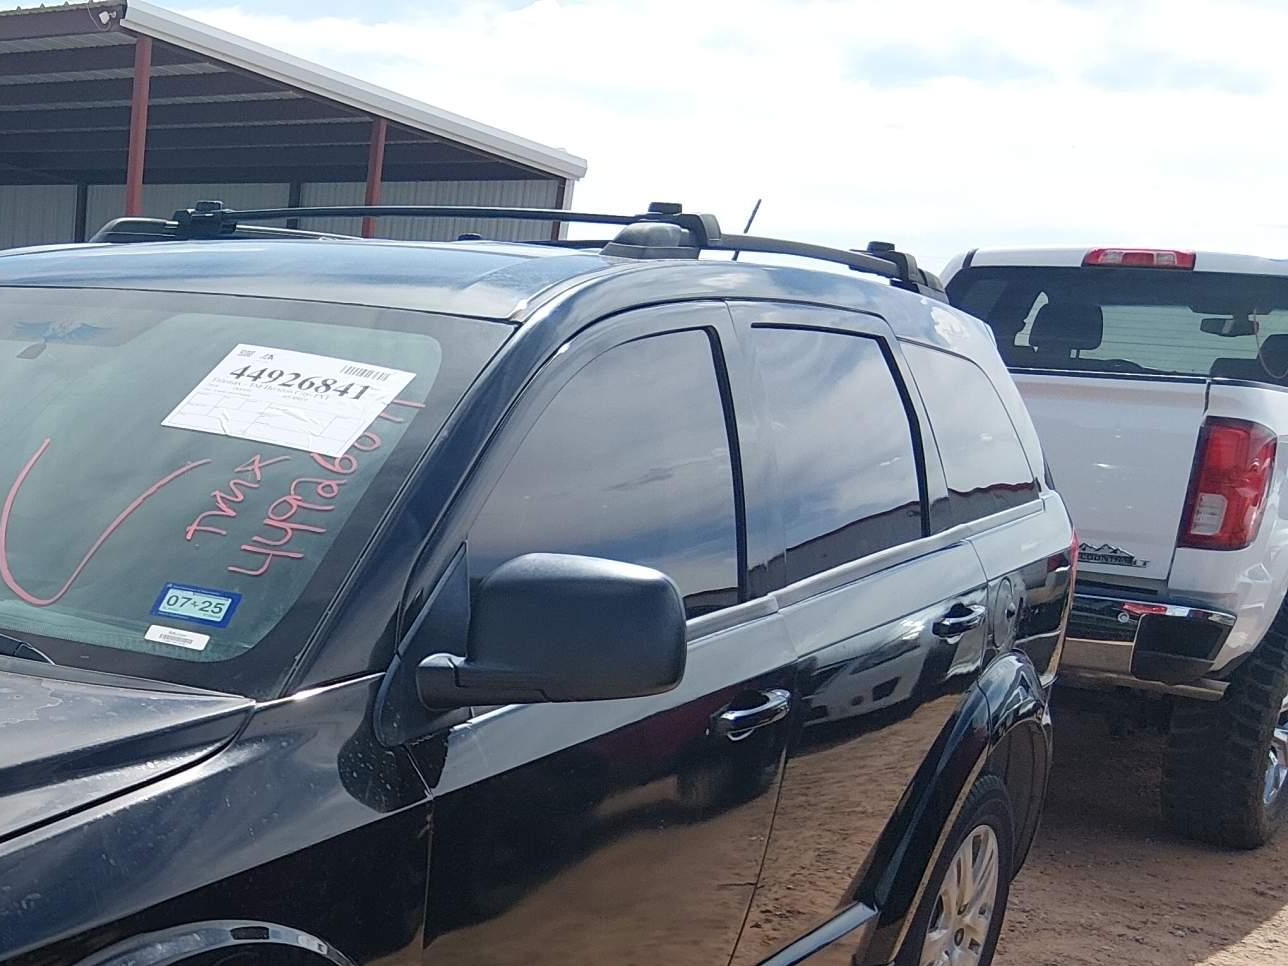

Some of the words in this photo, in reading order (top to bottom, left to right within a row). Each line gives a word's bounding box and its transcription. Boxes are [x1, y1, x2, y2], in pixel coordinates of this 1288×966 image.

[229, 364, 372, 400] 44926841
[166, 594, 193, 608] 07
[198, 600, 225, 615] 25
